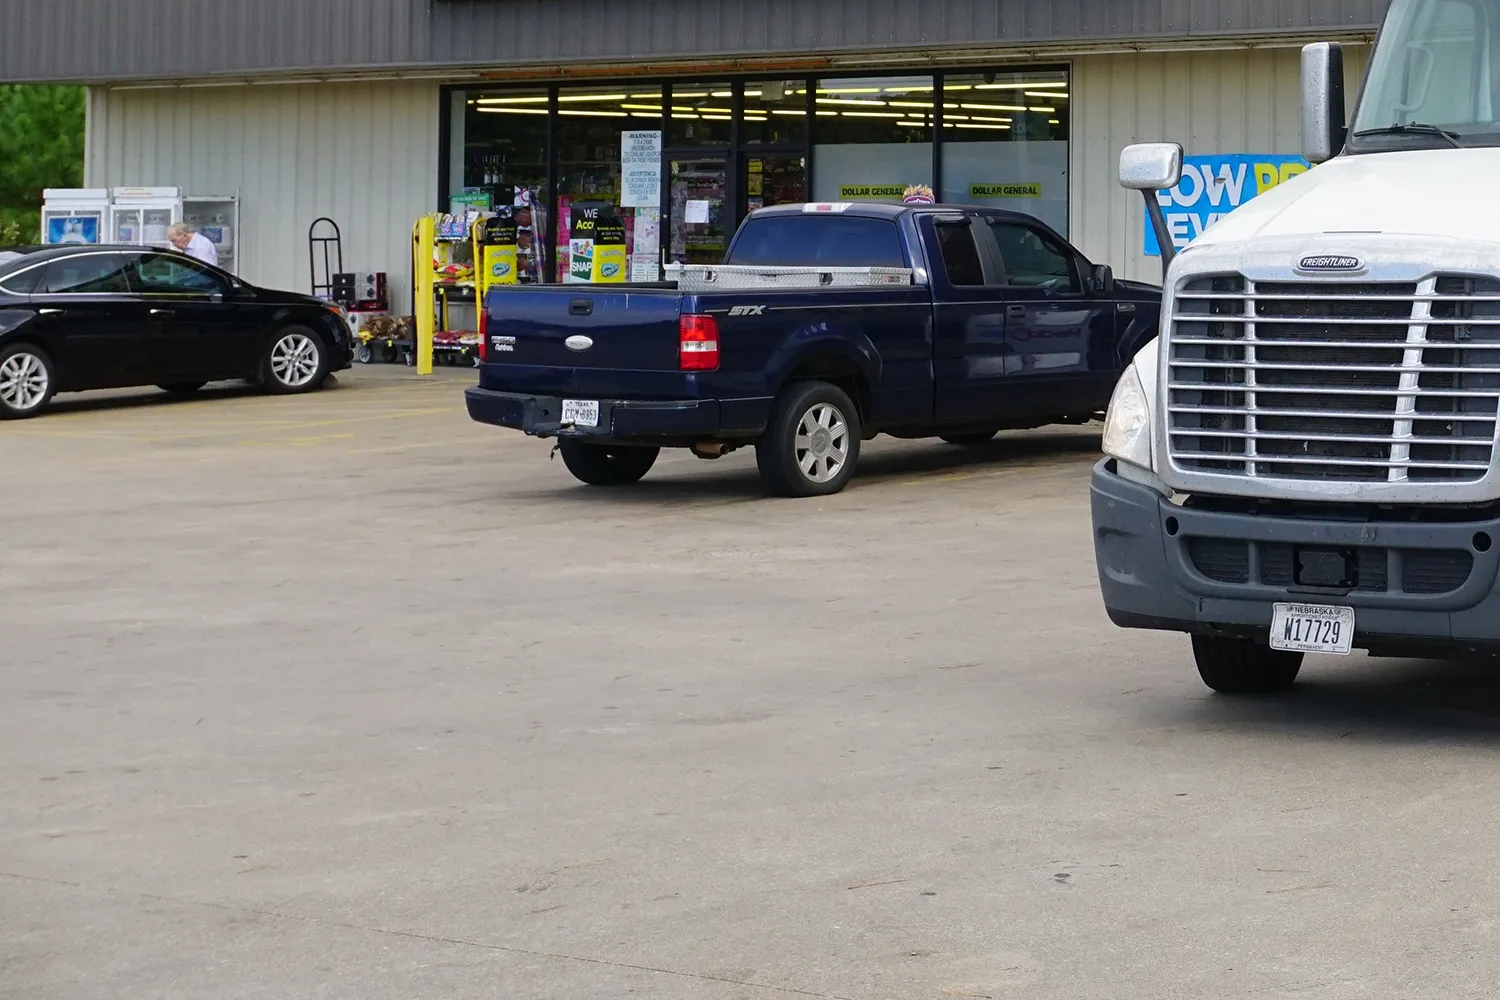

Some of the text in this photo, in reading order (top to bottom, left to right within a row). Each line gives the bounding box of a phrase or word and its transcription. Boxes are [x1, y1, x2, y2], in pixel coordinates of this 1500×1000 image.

[842, 187, 904, 196] DOLLAR GENERAL
[972, 185, 1038, 196] DOLLAR GENERAL
[584, 208, 599, 219] WE
[575, 219, 595, 230] Acc
[571, 261, 592, 272] SNAP
[1302, 257, 1357, 267] FREIGHTLINER
[728, 305, 766, 316] STX
[1294, 606, 1334, 616] NEBRASKA
[1284, 617, 1341, 645] W17729
